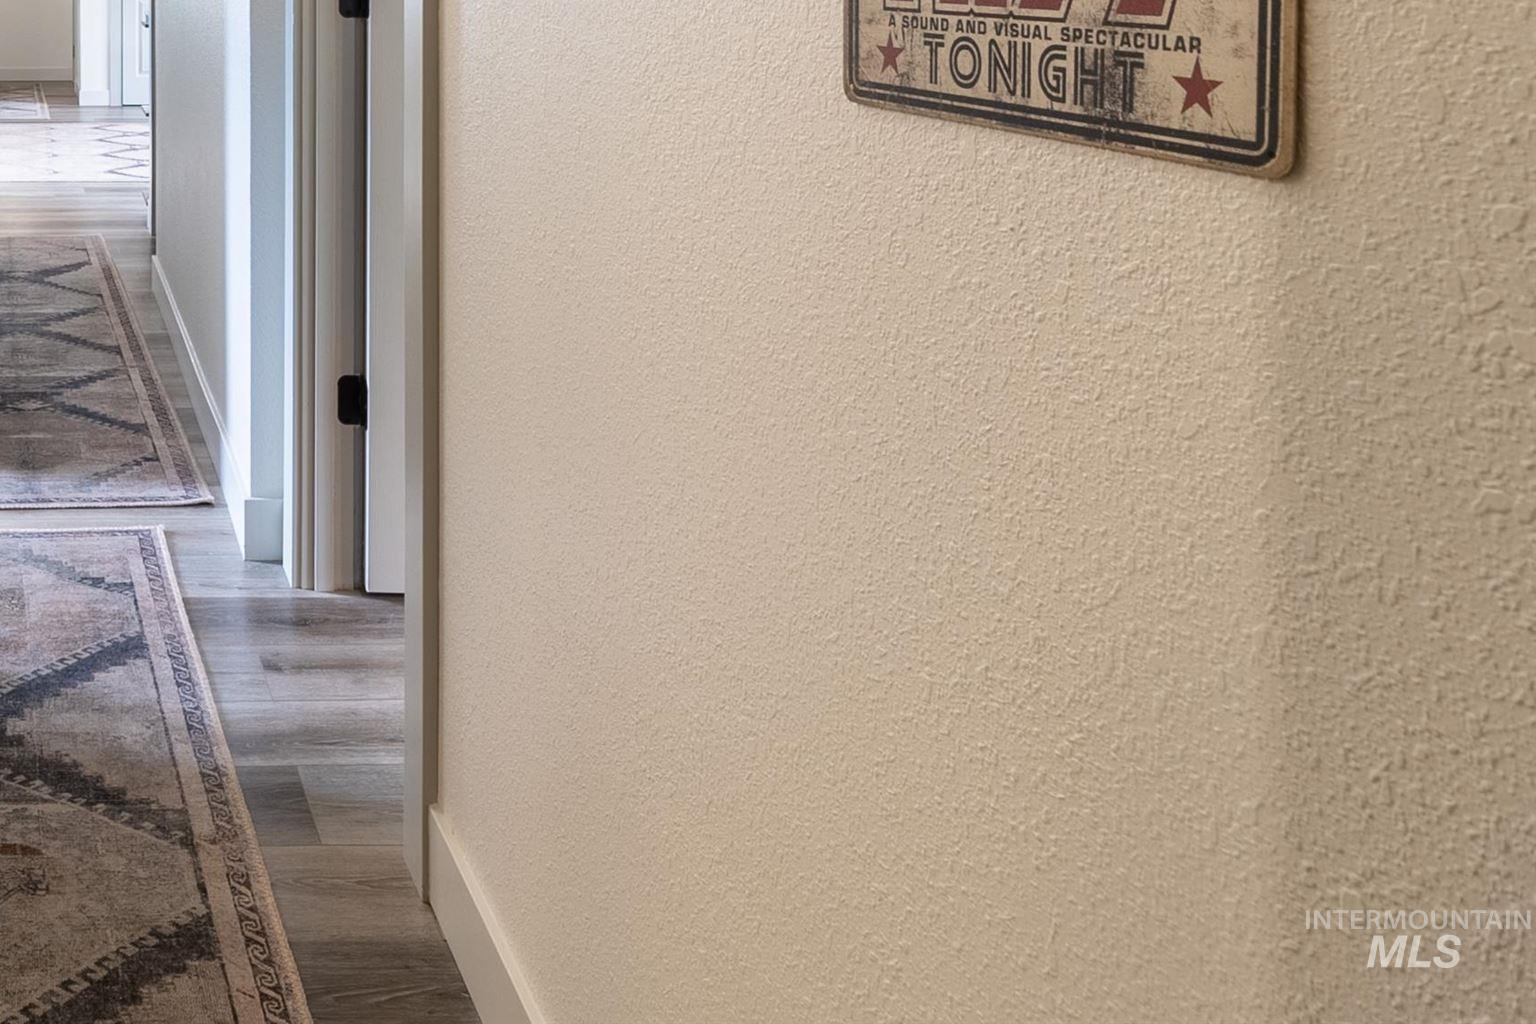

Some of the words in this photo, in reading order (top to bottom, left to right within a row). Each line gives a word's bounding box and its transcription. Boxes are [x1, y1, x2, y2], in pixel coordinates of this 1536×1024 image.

[888, 14, 896, 28] A
[902, 17, 949, 32] SOUND
[955, 18, 988, 36] AND
[994, 20, 1052, 42] VISUAL
[1060, 27, 1202, 54] SPECTACULAR
[923, 33, 1145, 114] TONIGHT
